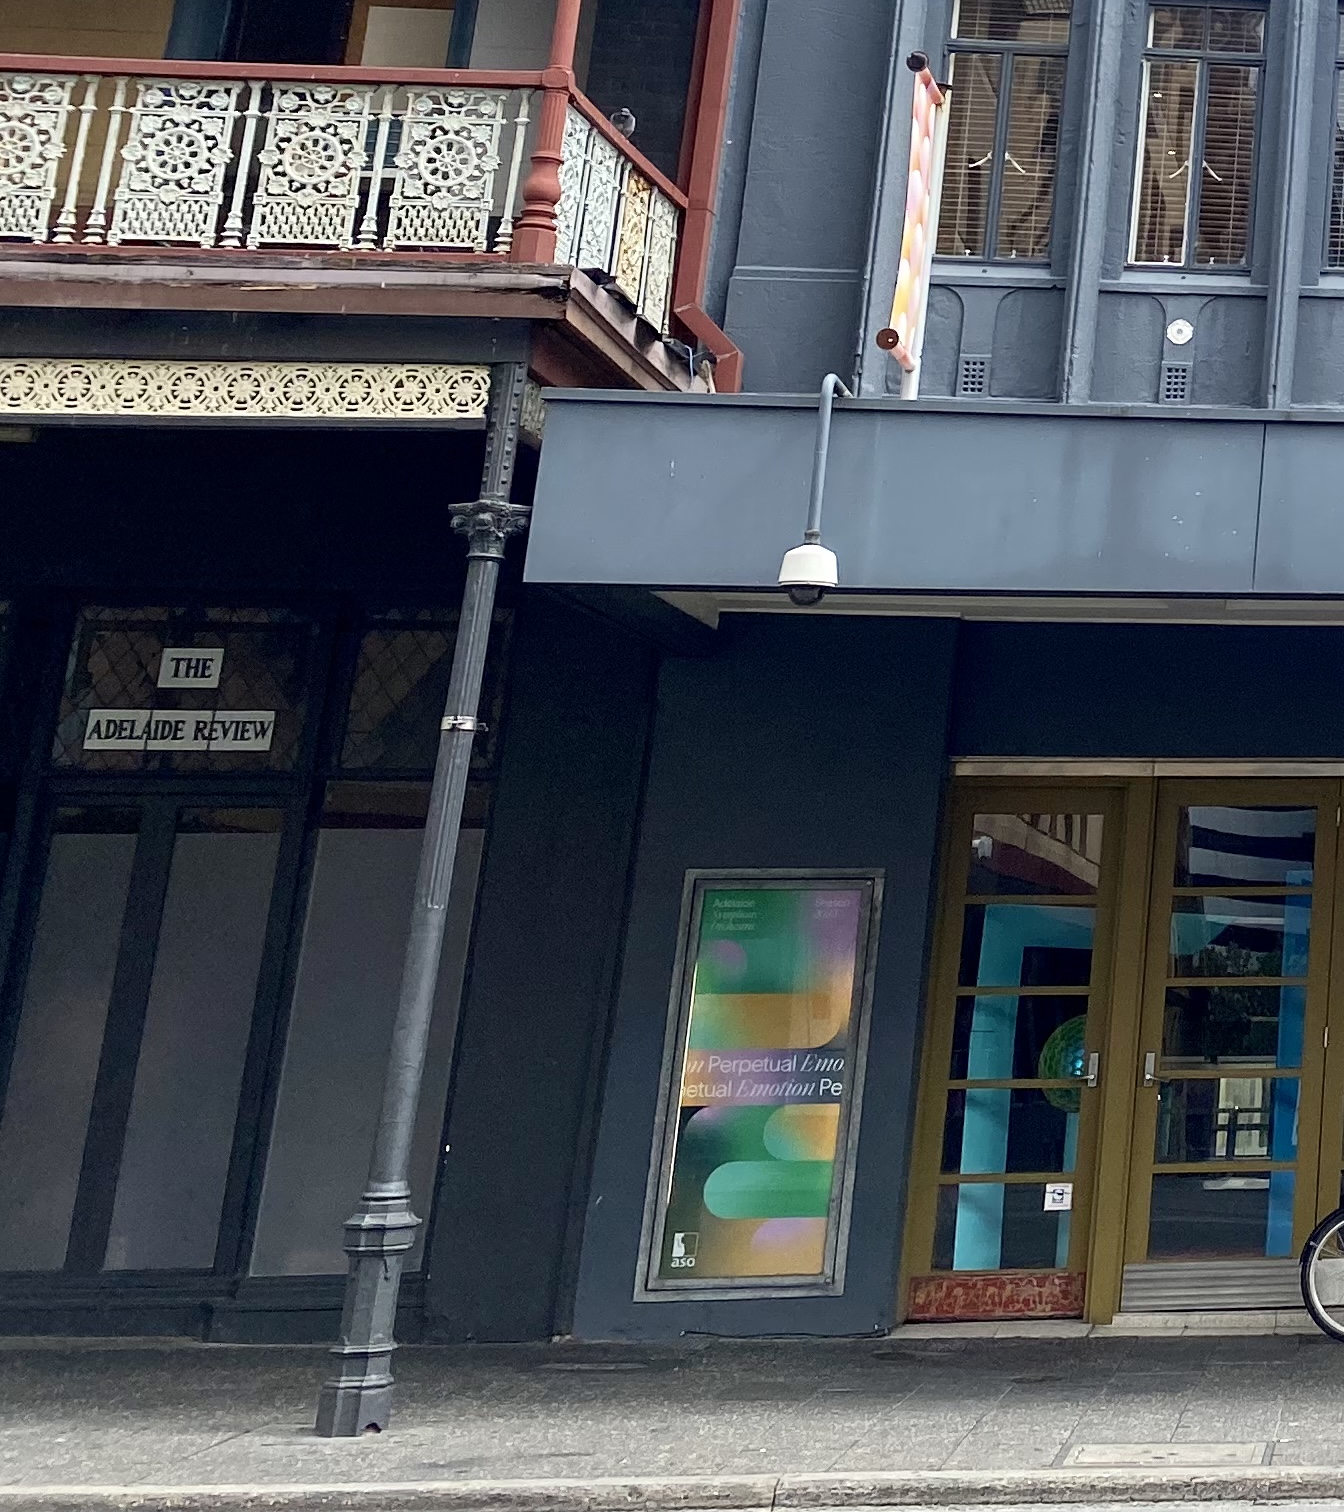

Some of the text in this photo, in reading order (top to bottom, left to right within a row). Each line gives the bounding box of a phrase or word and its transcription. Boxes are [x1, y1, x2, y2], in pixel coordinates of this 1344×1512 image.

[170, 657, 214, 678] THE
[86, 719, 273, 741] ADELAIDE REVIEW
[708, 1054, 797, 1075] Perpetual
[735, 1079, 816, 1097] Emotion
[819, 1078, 842, 1095] Pe
[671, 1257, 695, 1267] aso
